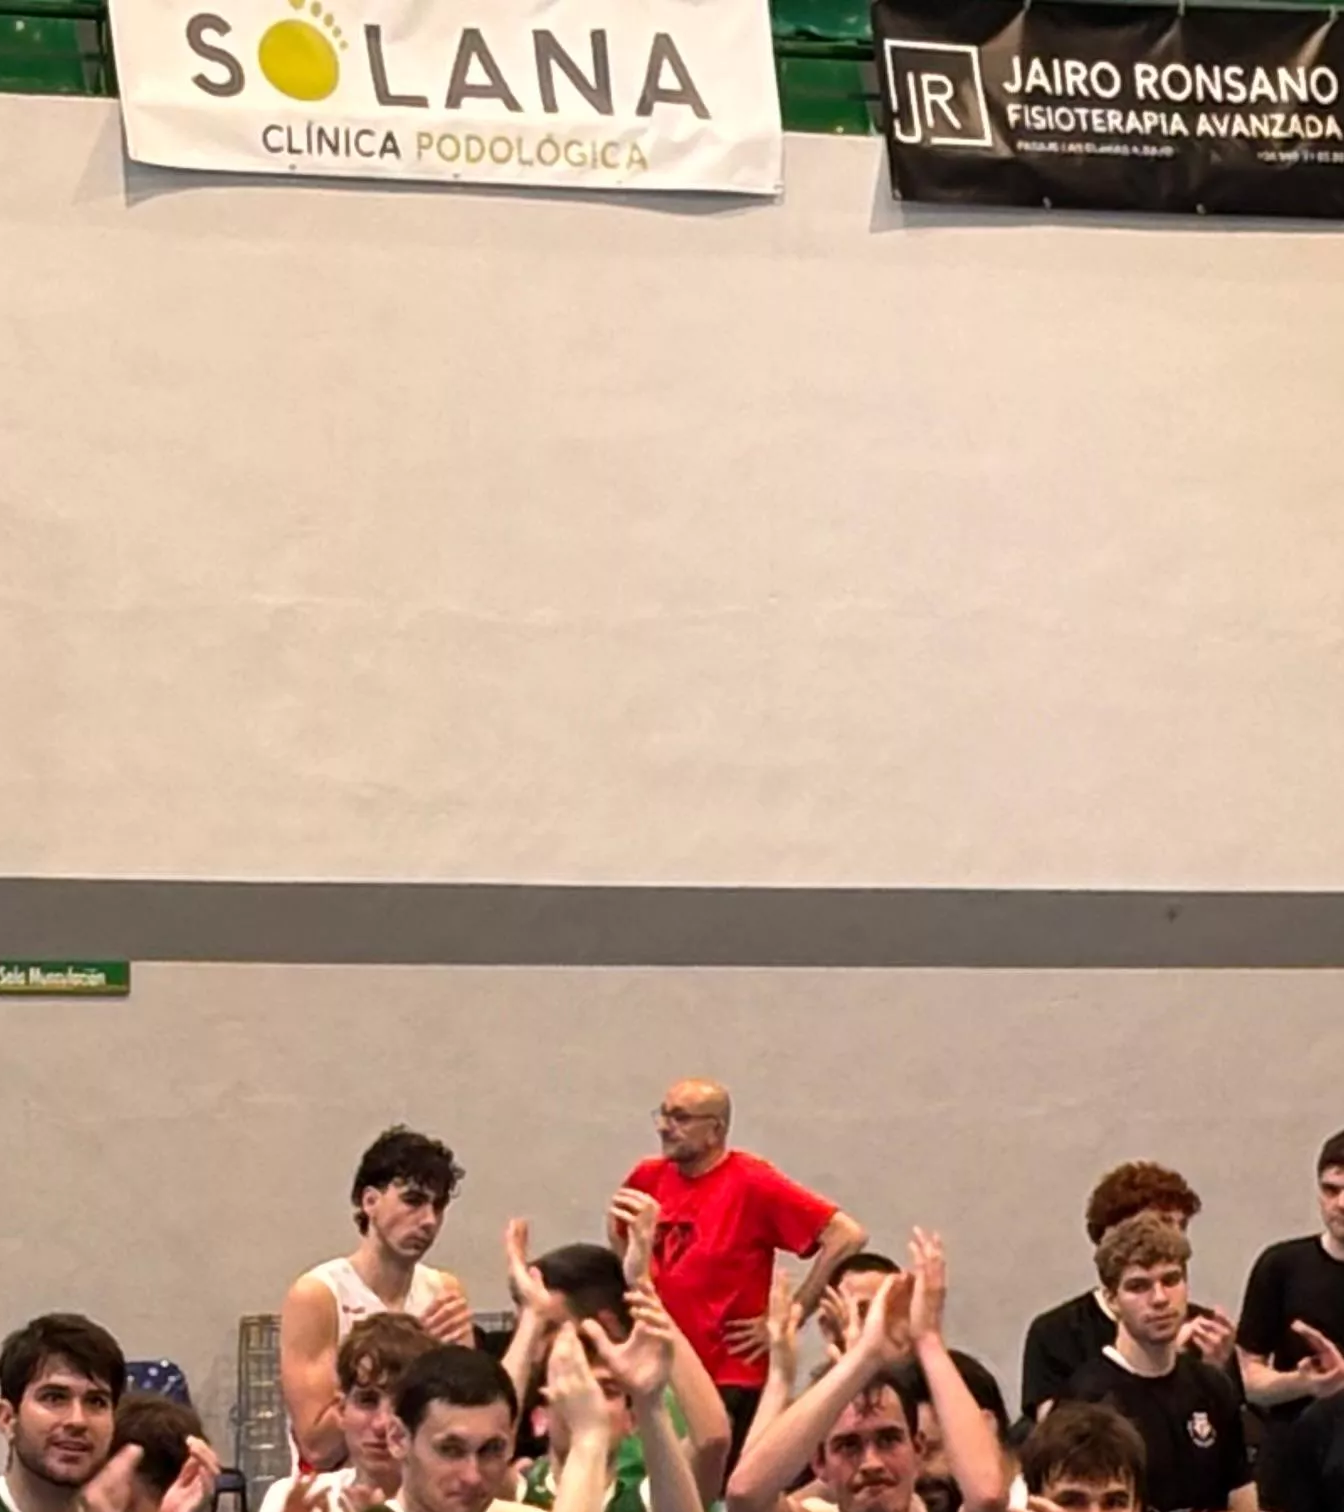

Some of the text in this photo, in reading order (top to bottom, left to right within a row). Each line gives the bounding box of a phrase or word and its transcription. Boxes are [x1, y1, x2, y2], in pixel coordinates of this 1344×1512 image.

[1003, 56, 1339, 105] JAIRO RONSANO
[262, 119, 649, 171] CLÍNICA PODOLÓGICA
[1007, 104, 1343, 141] FISIOTERAPIA AVANZADA
